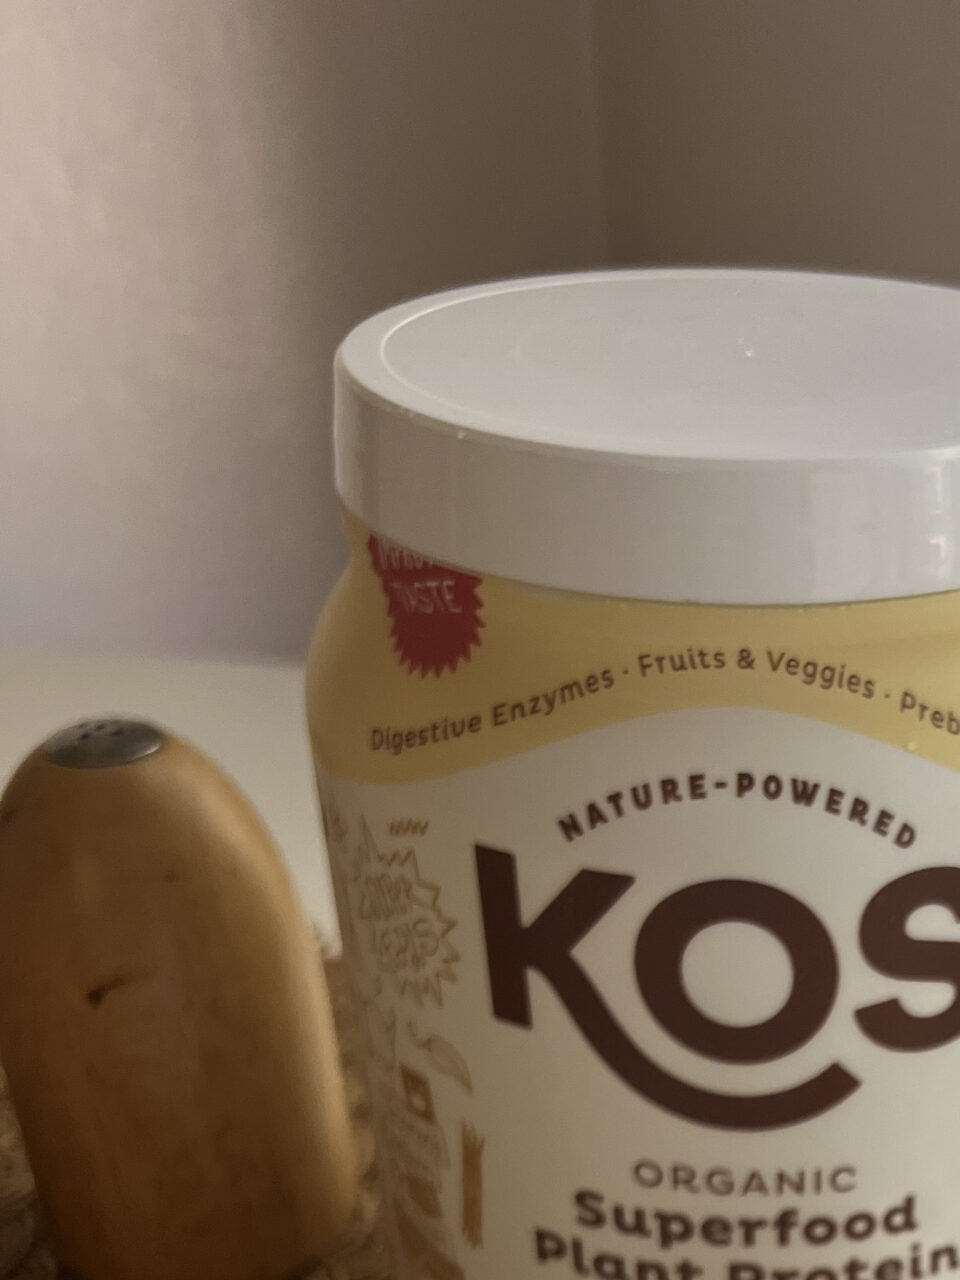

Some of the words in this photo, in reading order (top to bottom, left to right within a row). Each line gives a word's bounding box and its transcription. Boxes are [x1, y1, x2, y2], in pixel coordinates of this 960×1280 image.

[391, 578, 463, 614] TASTE
[369, 712, 483, 756] Digestive
[492, 666, 615, 728] Enzymes
[638, 647, 726, 677] Fruits
[737, 649, 757, 669] &
[766, 650, 876, 699] Veggies
[556, 772, 918, 849] NATURE-POWERED
[633, 1158, 858, 1196] ORGANIC
[573, 1188, 919, 1250] Superfood
